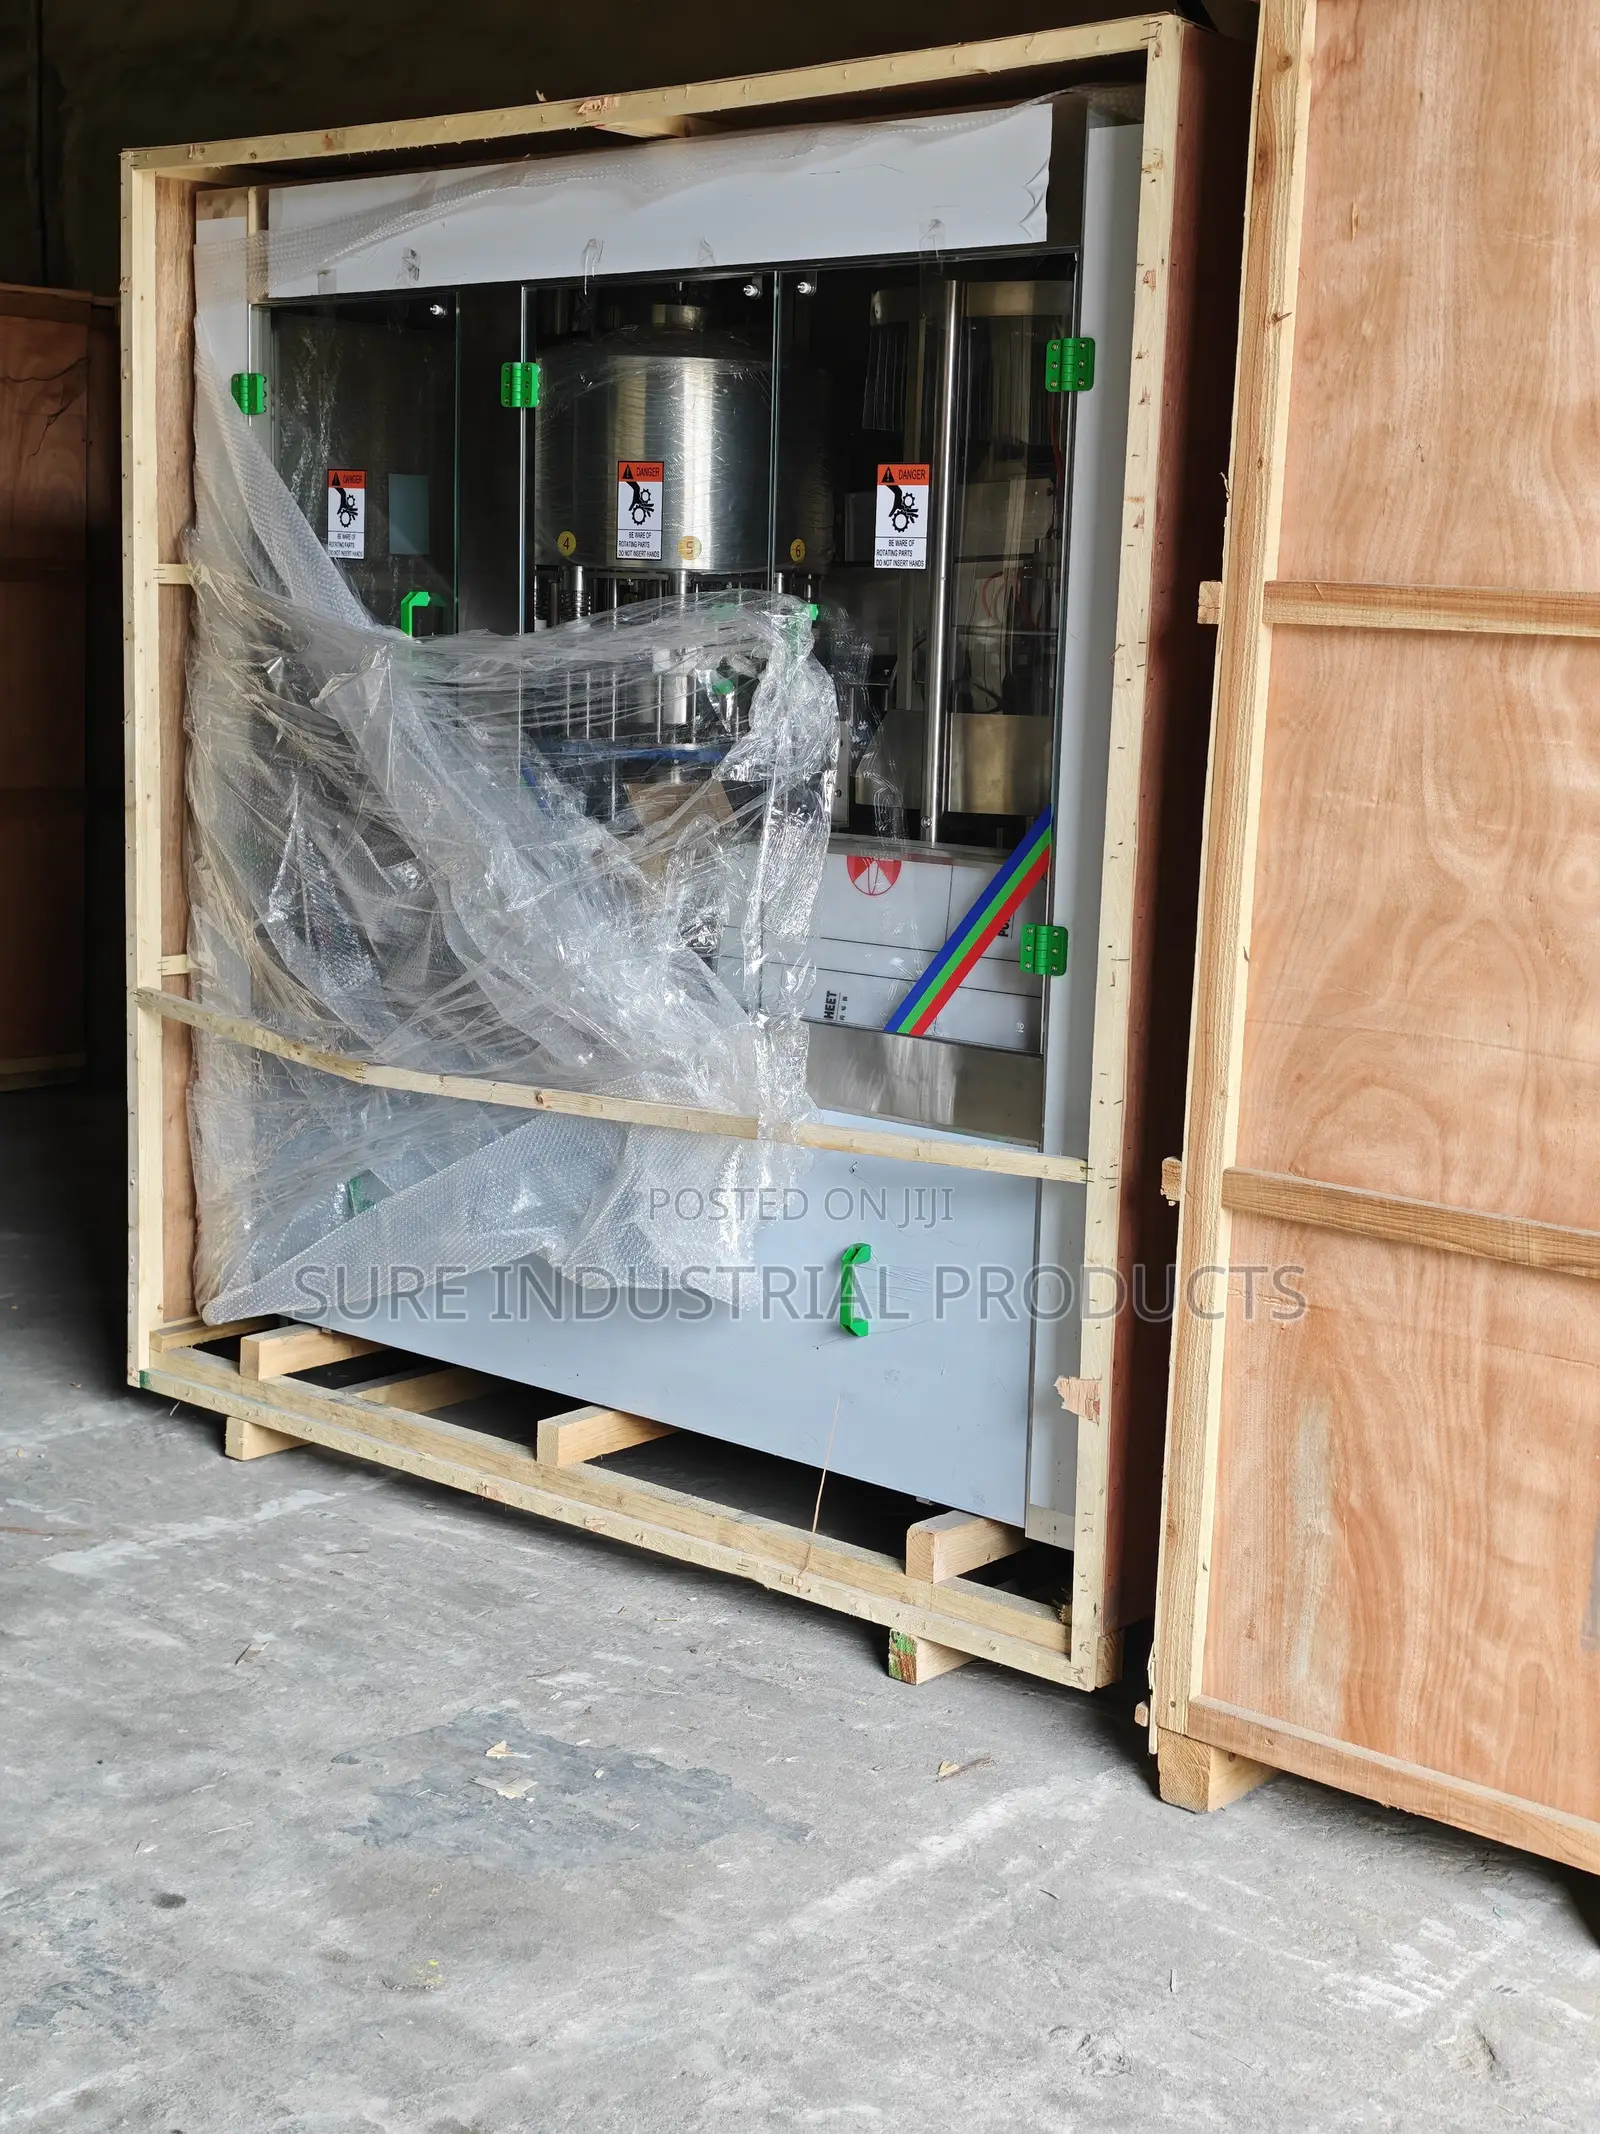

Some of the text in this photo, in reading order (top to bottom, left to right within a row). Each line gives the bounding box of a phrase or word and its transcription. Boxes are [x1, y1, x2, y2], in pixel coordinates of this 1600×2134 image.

[636, 466, 660, 477] DANGER
[898, 469, 926, 480] DANGER
[628, 531, 635, 539] BE
[646, 531, 652, 539] OF
[562, 537, 570, 549] 4
[685, 541, 694, 554] 5
[888, 539, 915, 547] BE WARE OF
[624, 549, 633, 557] NOT
[633, 550, 647, 558] INSERT
[646, 550, 660, 558] HANDS
[795, 543, 801, 557] 6
[876, 549, 913, 557] ROTATING PARTS
[876, 559, 925, 568] DO NOT INSERT HANDS
